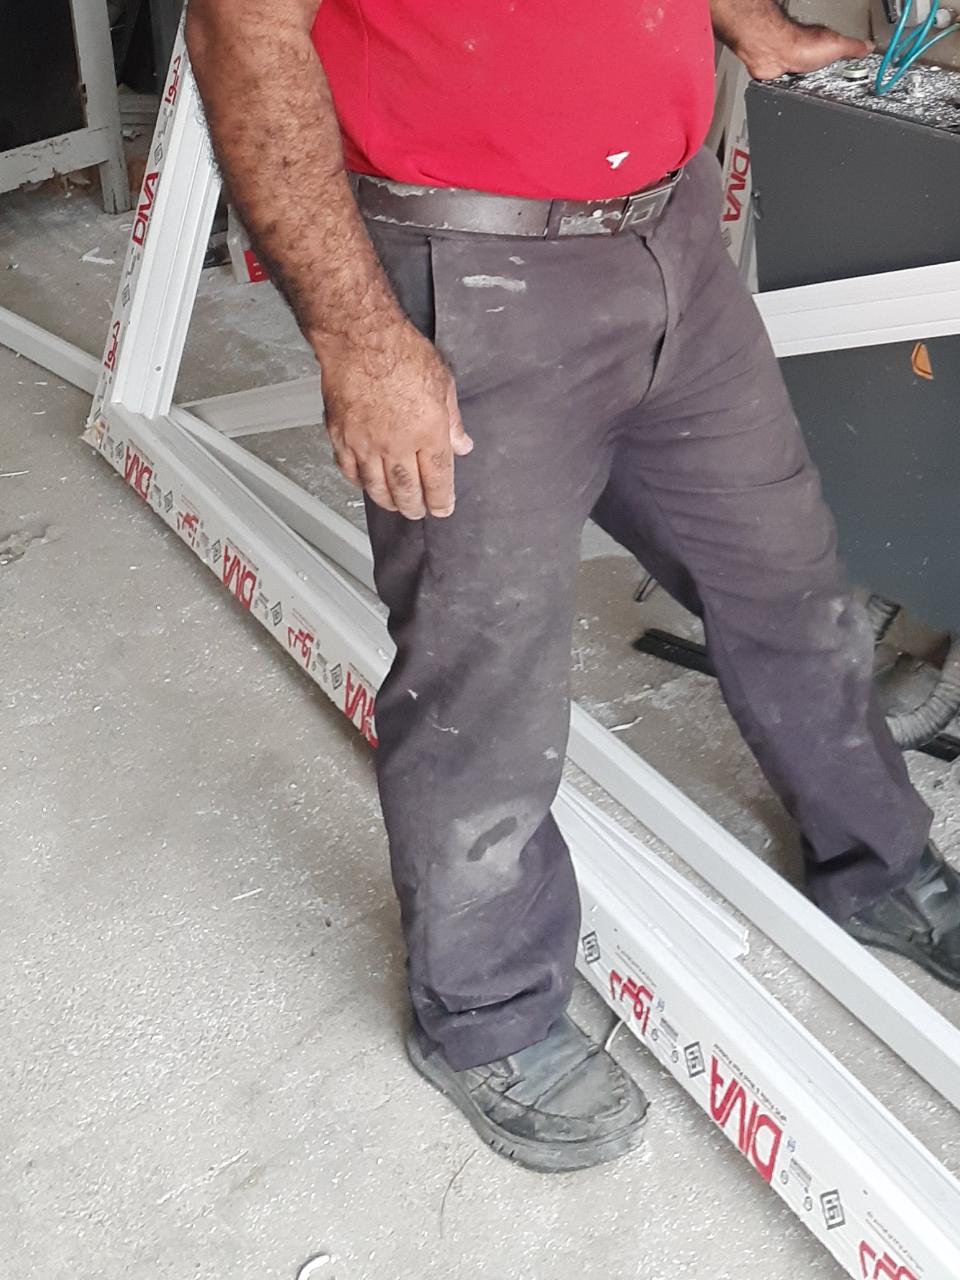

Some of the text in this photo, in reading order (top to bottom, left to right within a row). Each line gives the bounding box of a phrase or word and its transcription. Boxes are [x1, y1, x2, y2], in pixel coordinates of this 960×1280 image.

[131, 171, 160, 246] DIVA
[720, 147, 751, 223] DIVA
[123, 446, 154, 501] DIVA
[222, 545, 258, 610] DIVA
[709, 1054, 784, 1187] DIVA
